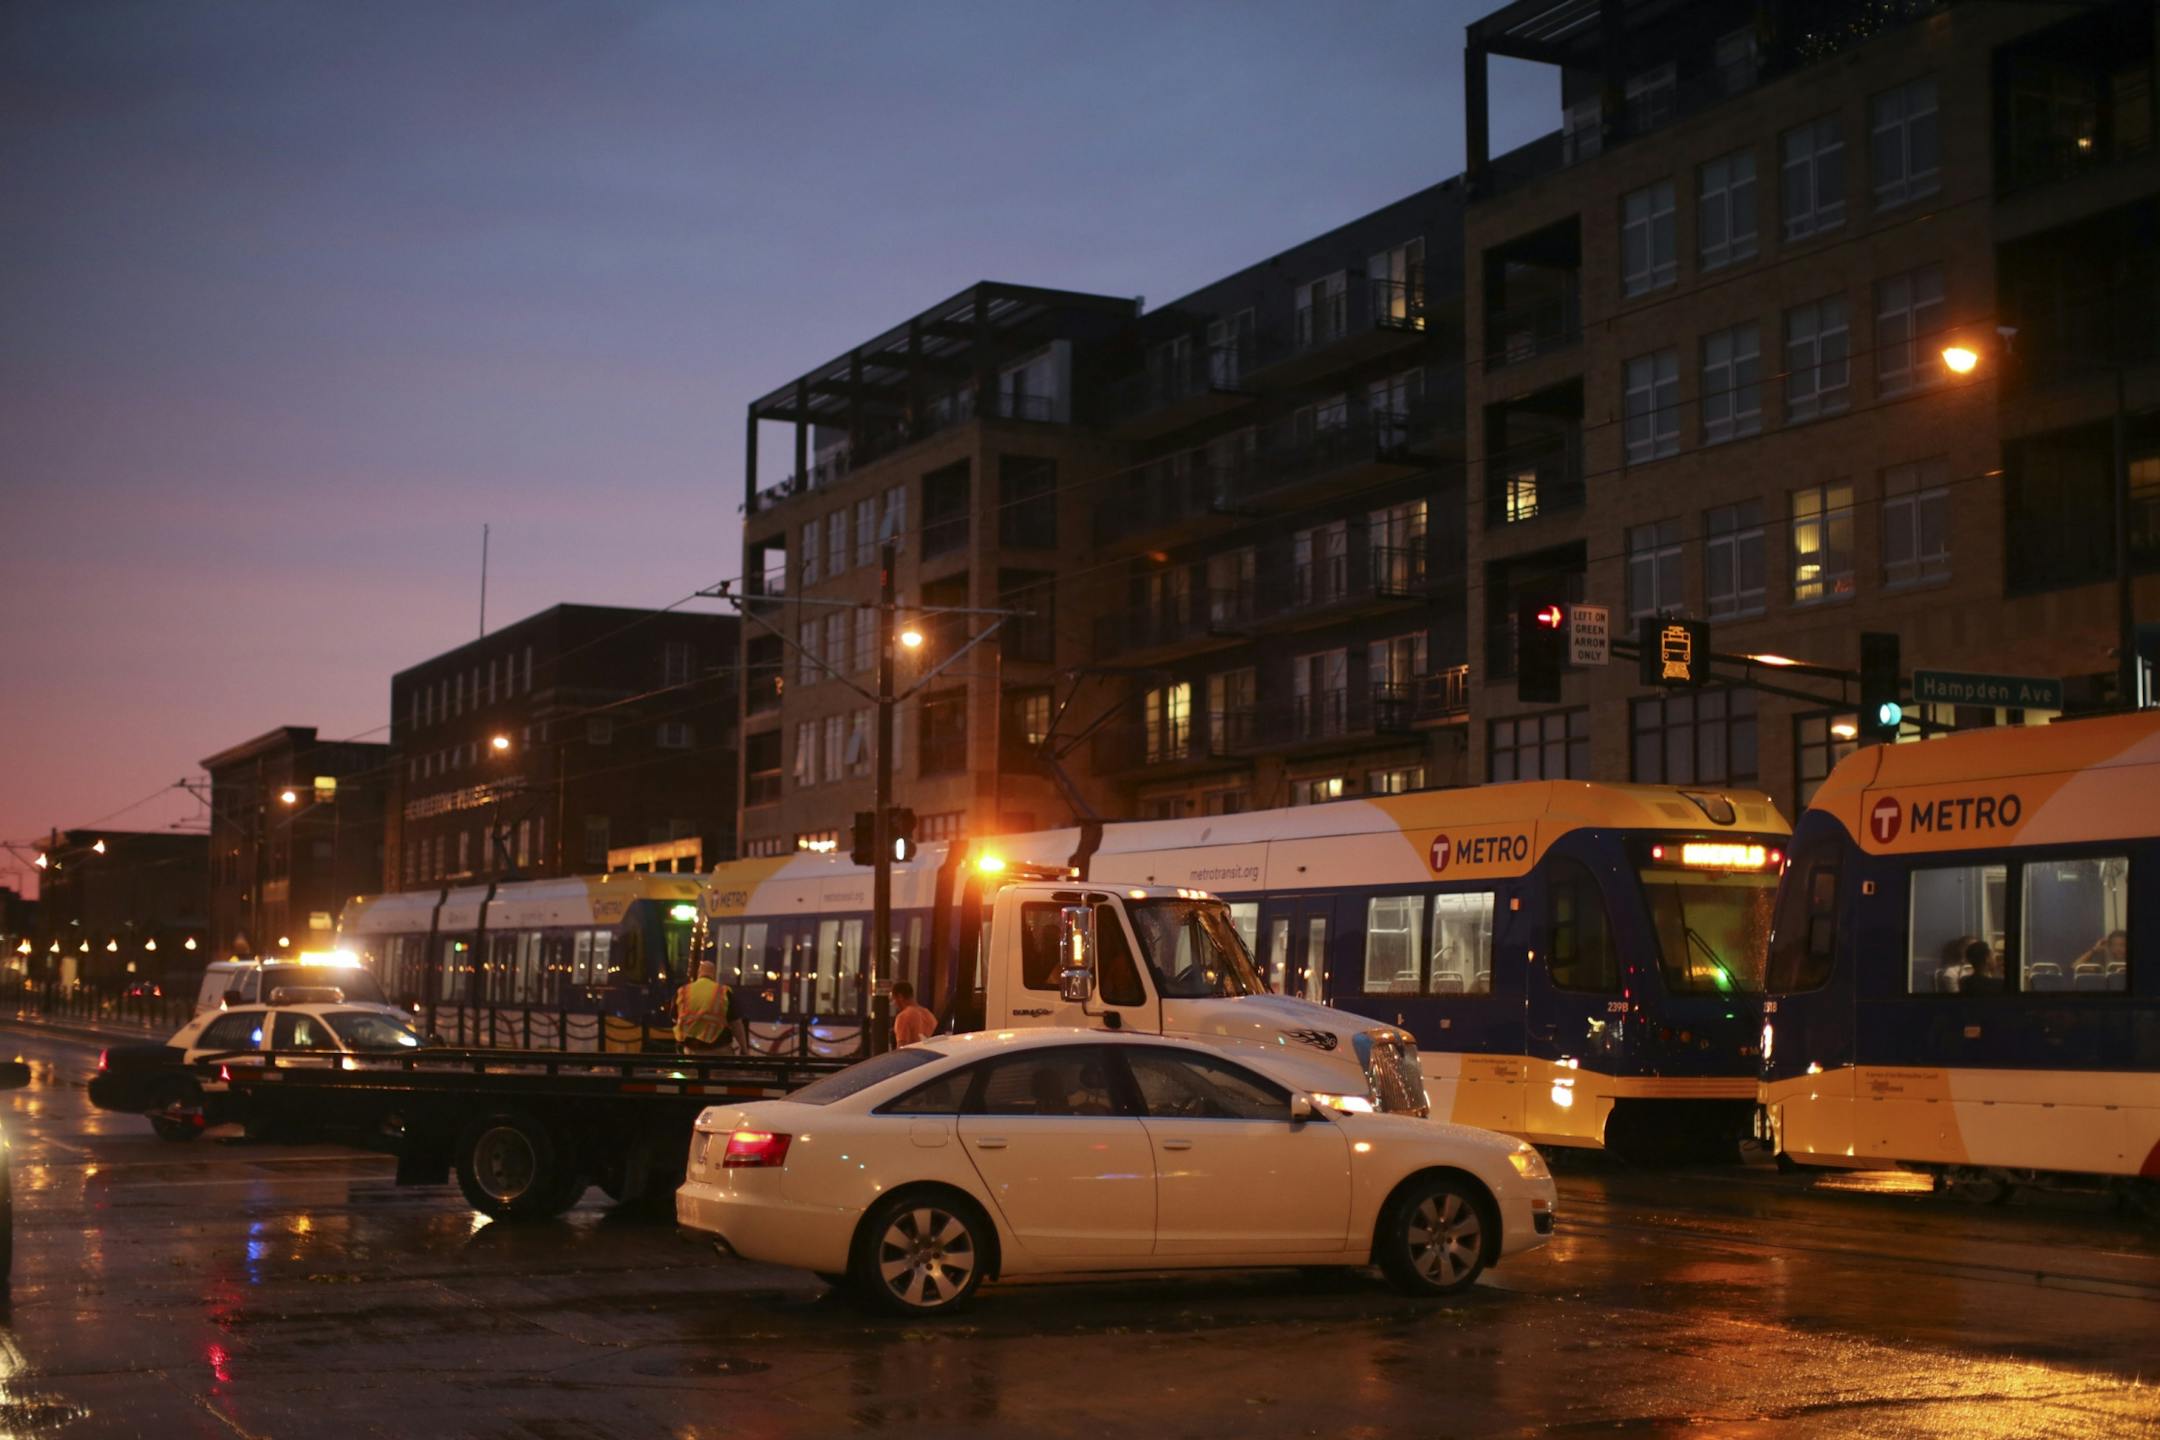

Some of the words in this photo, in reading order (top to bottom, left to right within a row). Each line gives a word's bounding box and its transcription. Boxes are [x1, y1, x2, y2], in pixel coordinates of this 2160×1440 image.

[1573, 611, 1592, 621] LEFT
[1595, 612, 1606, 622] ON
[1575, 624, 1604, 634] GREEN
[1574, 637, 1605, 648] ARROW
[1578, 650, 1602, 661] ONLY
[1923, 677, 2009, 701] Hampden
[2019, 684, 2053, 703] Ave
[1910, 794, 2021, 833] METRO
[1456, 835, 1528, 865] METRO
[1190, 864, 1259, 882] metrotransit.org
